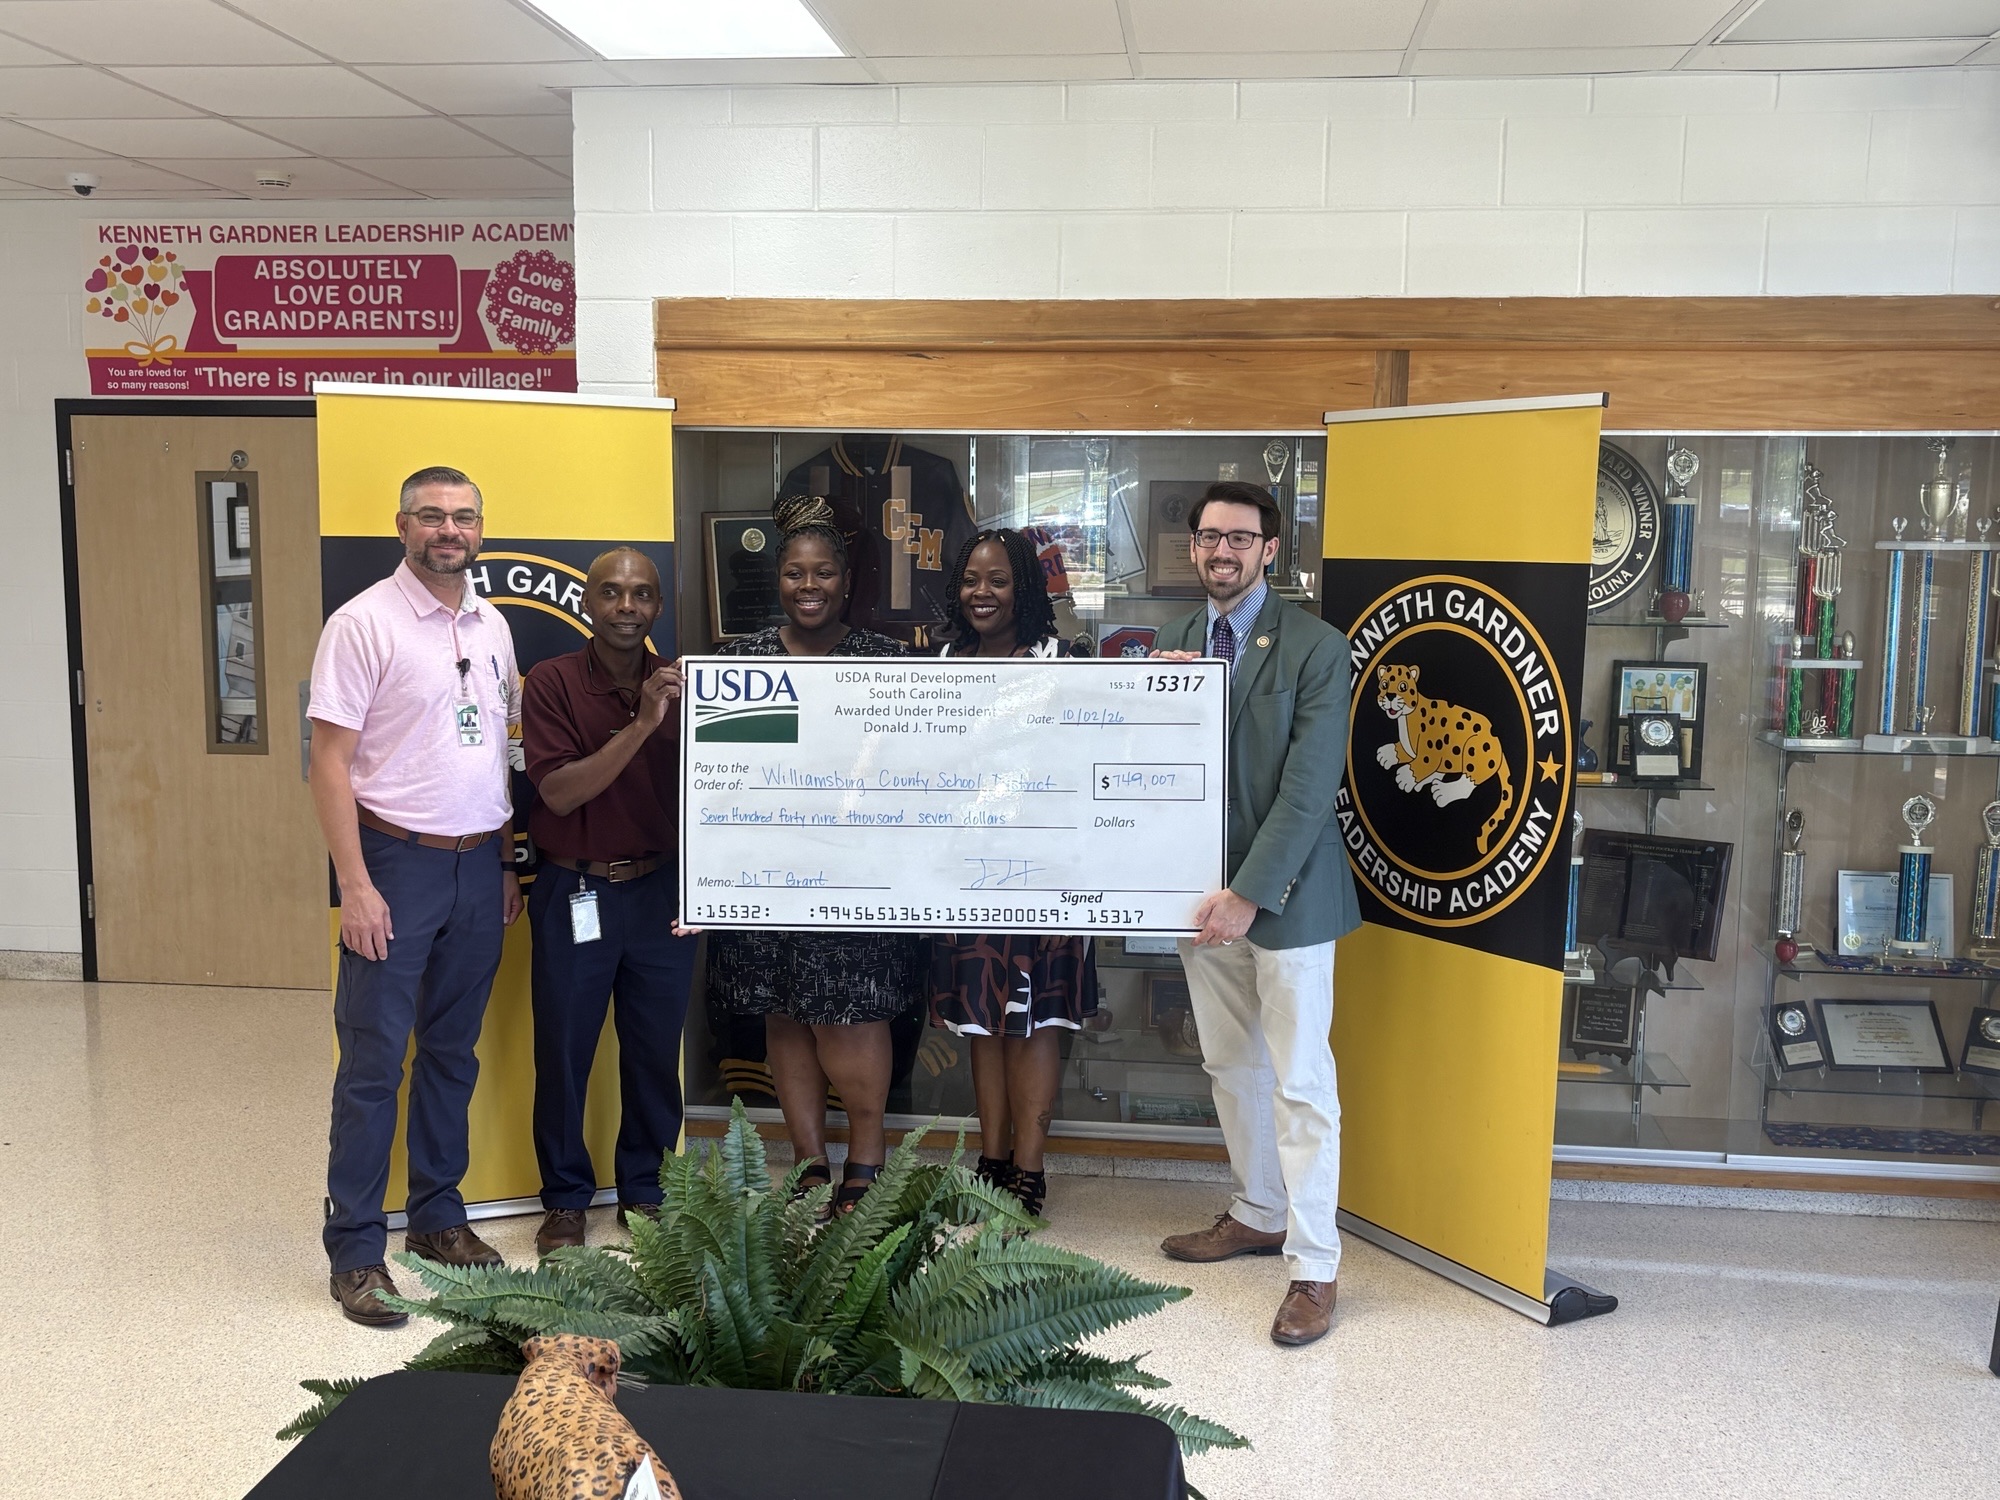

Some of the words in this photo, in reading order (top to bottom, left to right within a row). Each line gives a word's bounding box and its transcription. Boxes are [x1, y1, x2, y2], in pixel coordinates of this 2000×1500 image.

[99, 225, 202, 244] KENNETH
[209, 225, 317, 243] GARDNER
[325, 224, 465, 243] LEADERSHIP
[254, 259, 422, 279] ABSOLUTELY
[518, 265, 563, 292] Love
[274, 285, 340, 305] LOVE
[348, 285, 403, 305] OUR
[507, 286, 564, 316] Grace
[224, 310, 455, 331] GRANDPARENTS!!
[498, 307, 562, 343] Family
[107, 368, 126, 377] You
[128, 369, 144, 377] are
[146, 367, 171, 377] loved
[173, 367, 187, 377] for
[194, 367, 271, 387] "There
[277, 367, 297, 387] is
[305, 370, 376, 392] power
[384, 367, 404, 385] in
[412, 371, 452, 386] our
[458, 367, 551, 390] village!"
[107, 382, 119, 390] so
[121, 382, 146, 392] many
[149, 380, 190, 390] reasons!
[1600, 451, 1633, 481] ARD
[1631, 482, 1653, 540] WINNER
[883, 499, 944, 572] CEM
[1589, 569, 1634, 602] OLINA
[1445, 589, 1560, 739] GARDNER
[695, 669, 799, 702] USDA
[835, 672, 870, 683] USDA
[874, 672, 907, 683] Rural
[910, 672, 997, 686] Development
[1109, 681, 1136, 690] 155-32
[1146, 675, 1205, 692] 15317
[869, 688, 906, 700] South
[909, 688, 962, 700] Carolina
[834, 705, 890, 717] Awarded
[894, 705, 934, 717] Under
[937, 705, 997, 718] President
[1026, 713, 1055, 725] Date:
[864, 722, 909, 733] Donald
[912, 722, 922, 733] J.
[925, 722, 967, 736] Trump
[694, 762, 715, 776] Pay
[716, 763, 728, 774] to
[730, 762, 749, 774] the
[694, 779, 726, 791] Order
[728, 778, 744, 790] of:
[762, 763, 866, 797] Williamsburg
[879, 769, 929, 794] County
[937, 772, 982, 789] School
[991, 773, 1057, 790] Dstrict
[700, 807, 729, 824] Seven
[732, 806, 773, 824] Hundred
[779, 807, 805, 828] forty
[811, 814, 838, 825] nine
[846, 809, 904, 825] thousand
[918, 812, 953, 824] seven
[963, 810, 1007, 826] dollars
[1094, 816, 1136, 828] Dollars
[1334, 787, 1442, 911] EADERSHIP
[1449, 797, 1552, 913] ACADEMY
[697, 876, 735, 888] Memo:
[785, 870, 829, 887] Grant
[1060, 891, 1103, 905] Signed
[1087, 909, 1144, 923] 15317
